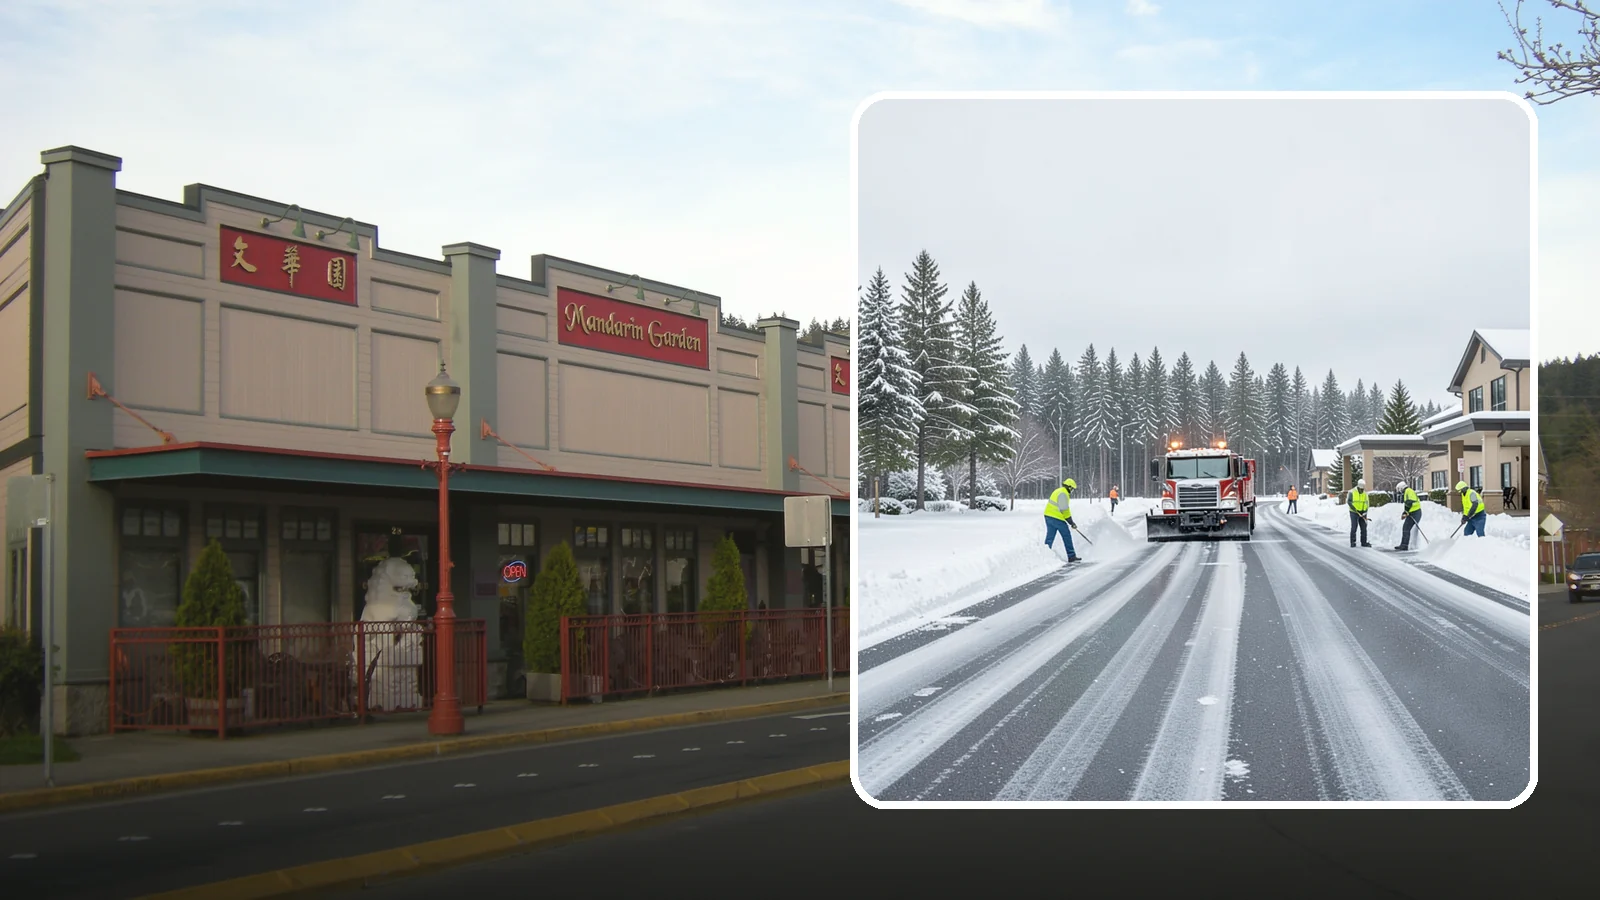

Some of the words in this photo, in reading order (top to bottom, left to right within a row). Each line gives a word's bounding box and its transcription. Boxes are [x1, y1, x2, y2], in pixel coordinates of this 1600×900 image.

[230, 235, 346, 291] 文華園
[564, 302, 644, 341] Mandarin
[648, 320, 702, 352] Garden
[503, 565, 527, 578] OPEN
